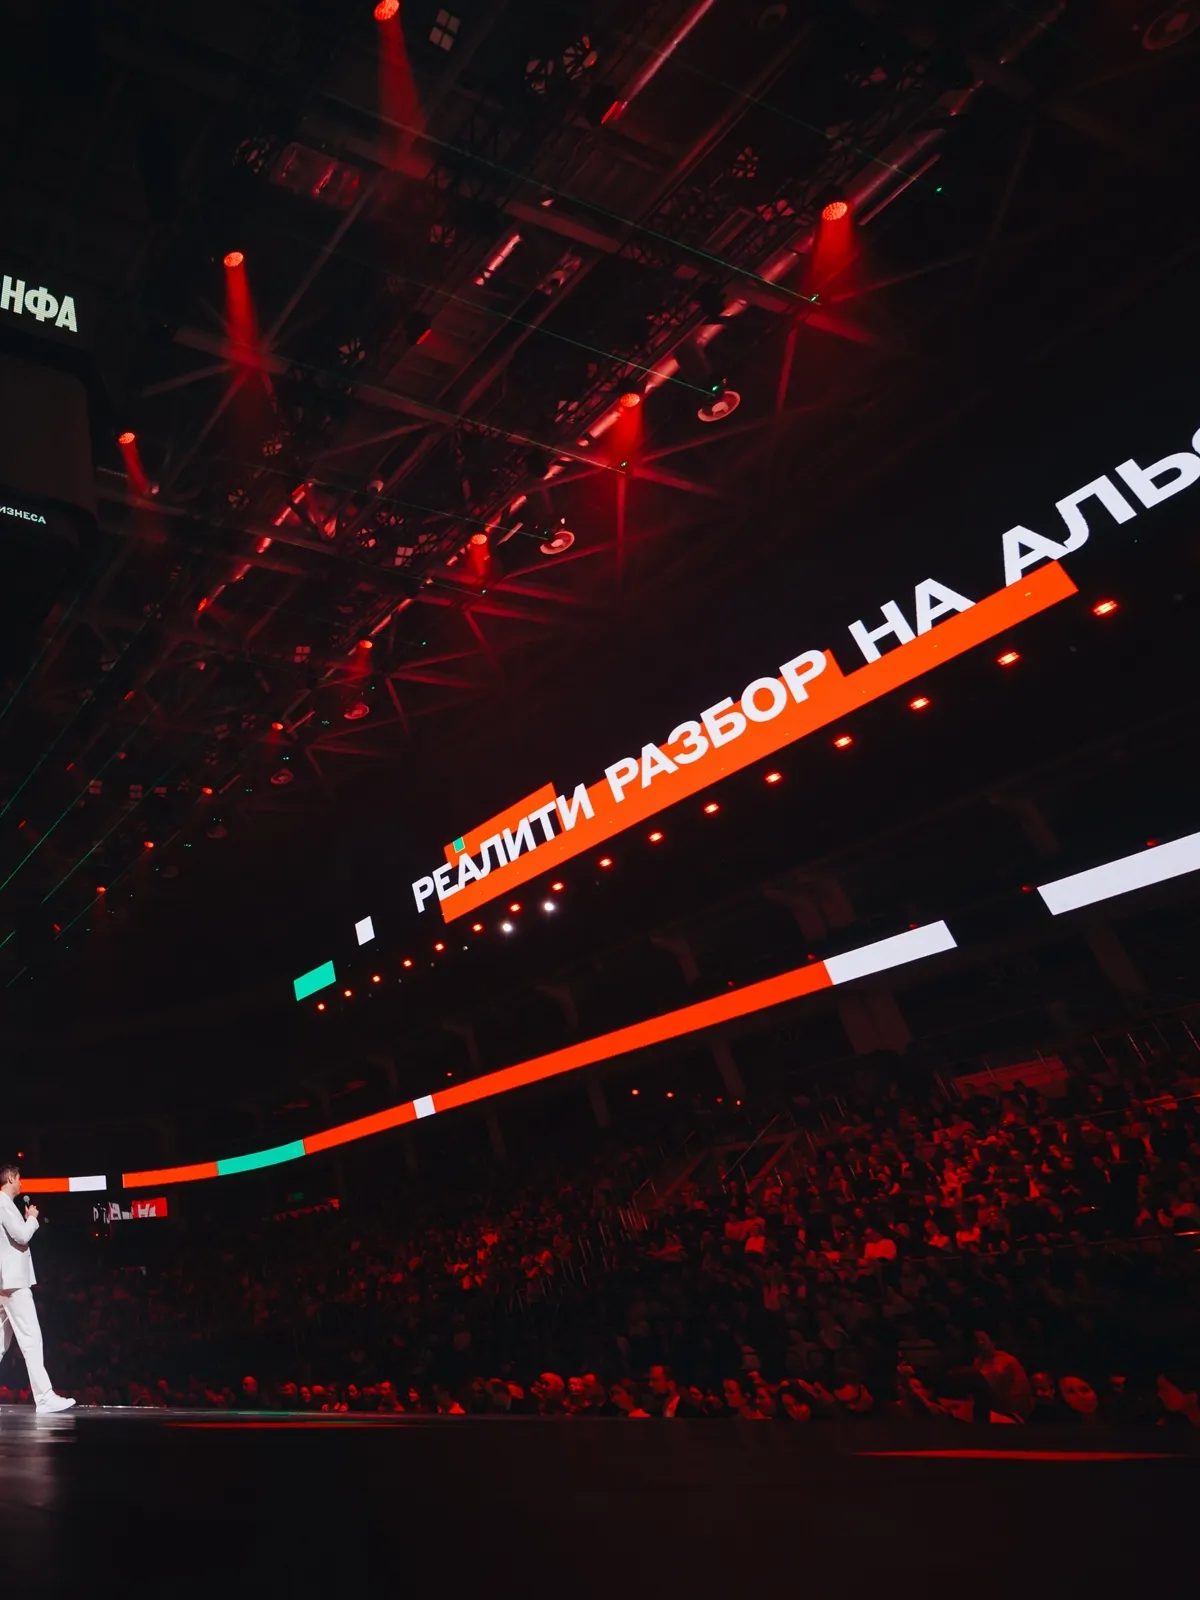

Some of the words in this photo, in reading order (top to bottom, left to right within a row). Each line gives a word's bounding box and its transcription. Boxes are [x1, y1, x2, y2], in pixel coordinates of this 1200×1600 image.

[411, 782, 595, 913] РЕАЛИТИ
[604, 649, 827, 803] РАЗБОР
[847, 578, 976, 664] НА
[1002, 428, 1200, 587] АЛЬ
